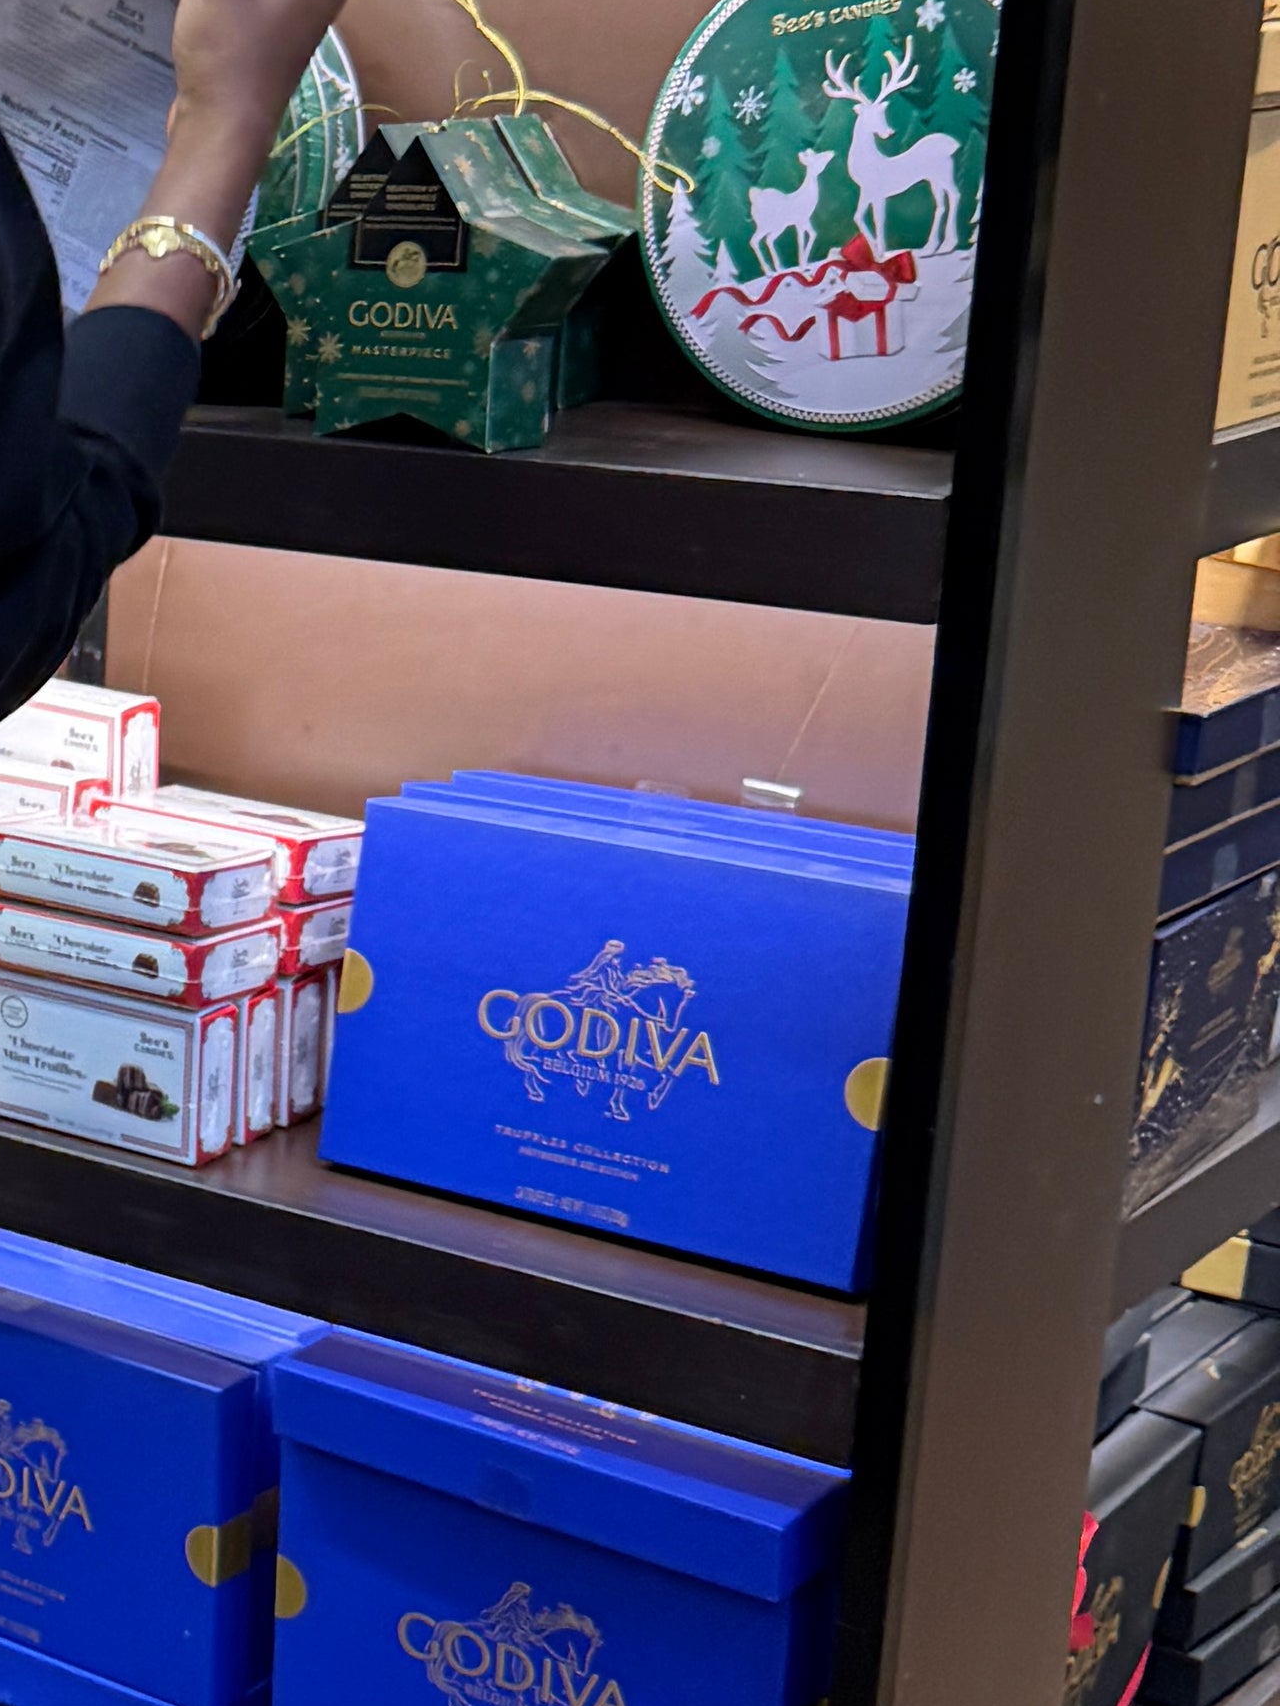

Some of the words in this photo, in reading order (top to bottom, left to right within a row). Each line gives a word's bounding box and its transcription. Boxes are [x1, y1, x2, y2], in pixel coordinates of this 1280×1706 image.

[772, 9, 826, 38] See's
[52, 121, 86, 146] Facts
[348, 300, 459, 330] GODIVA
[351, 345, 451, 359] MASTERPIECE
[54, 863, 114, 884] Chocolate
[52, 933, 112, 954] Chocolate
[7, 1033, 75, 1061] Chocolate
[139, 1030, 170, 1050] See's
[477, 989, 720, 1087] GODIVA
[2, 1047, 30, 1068] Mint
